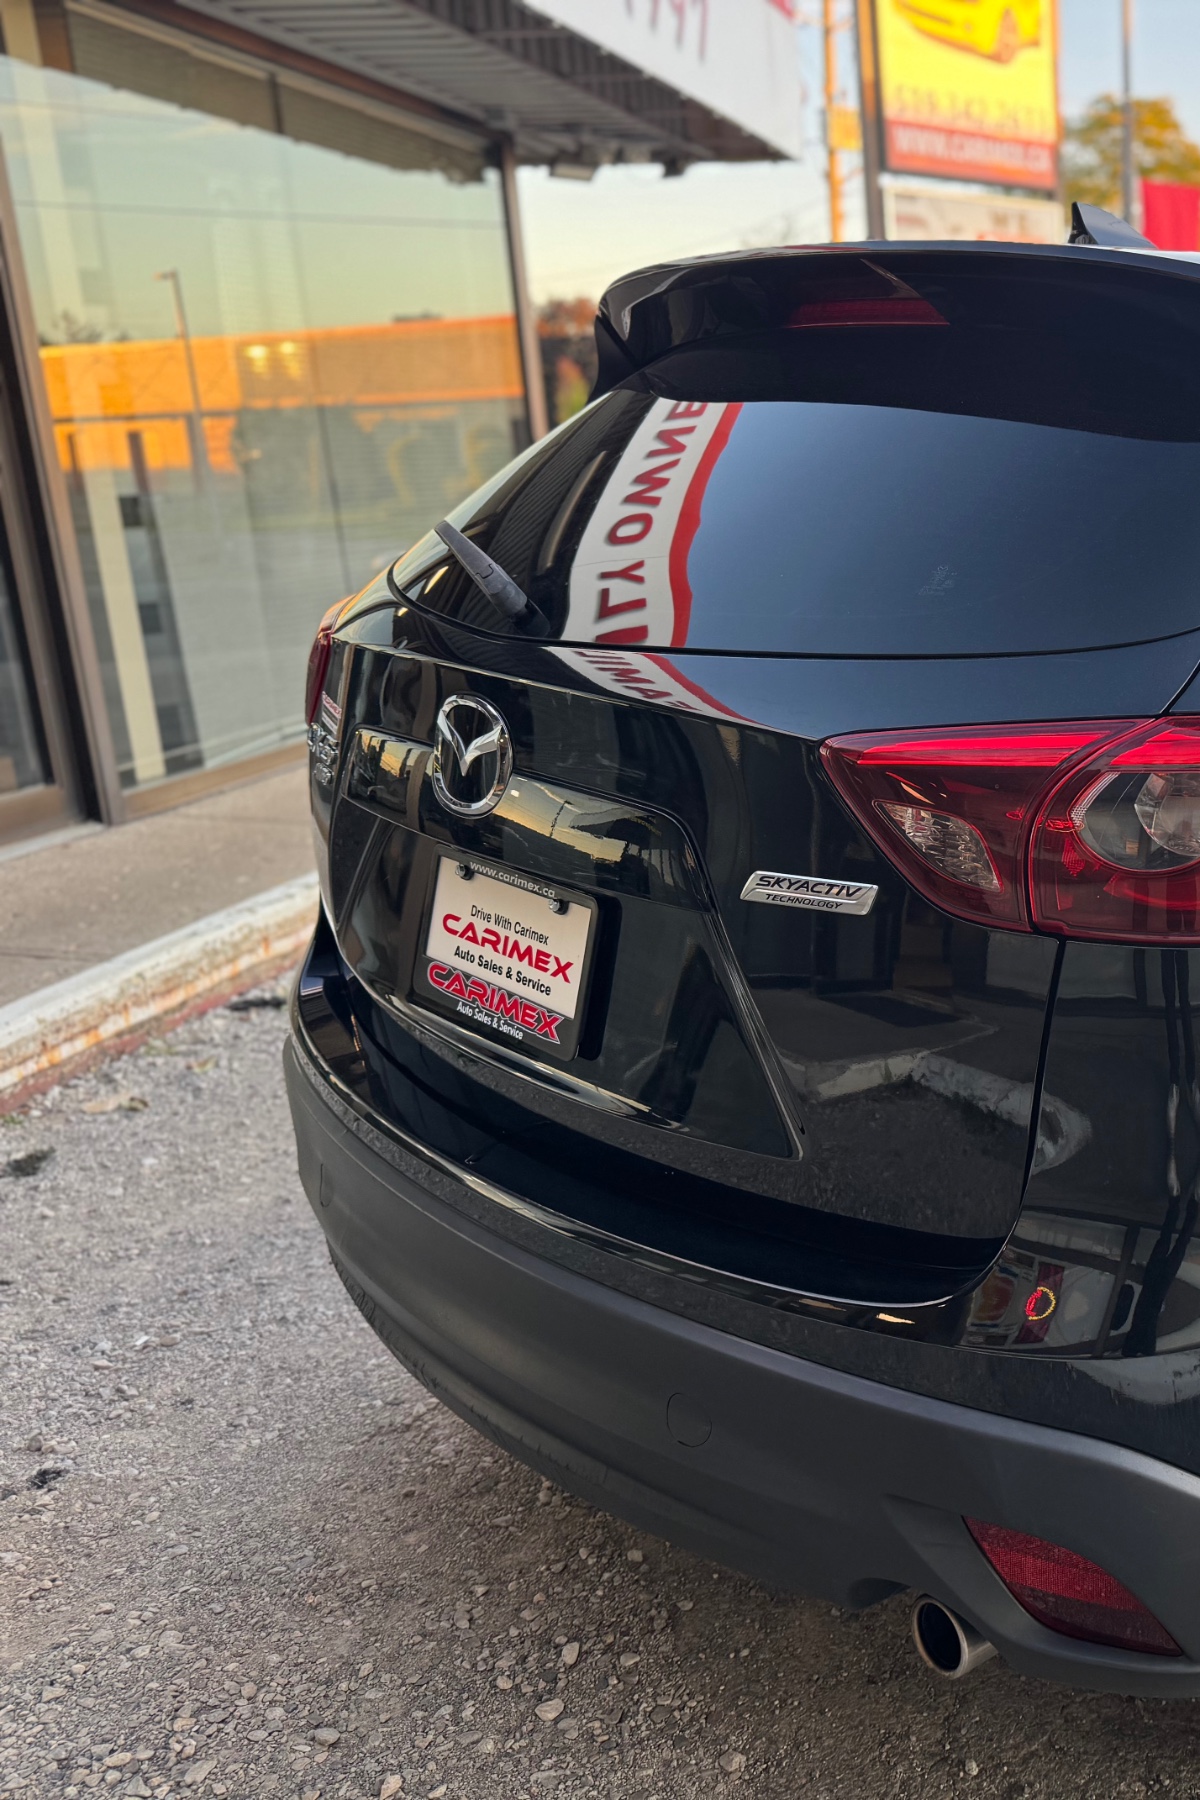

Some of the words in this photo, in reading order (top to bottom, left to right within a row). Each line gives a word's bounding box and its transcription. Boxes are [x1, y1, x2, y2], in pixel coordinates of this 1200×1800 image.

[469, 861, 556, 898] www.carimex.ca
[755, 875, 862, 897] SKYACTIV
[765, 893, 843, 909] TECHNOLOGY
[470, 904, 492, 923] Drive
[494, 912, 512, 931] With
[513, 921, 550, 946] Carimex
[442, 913, 574, 984] CARIMEX
[454, 945, 475, 964] Auto
[477, 954, 503, 976] Sales
[505, 966, 513, 980] &
[515, 970, 551, 996] Service
[428, 962, 562, 1042] CARIMEX
[456, 1001, 473, 1017] Auto
[473, 1009, 492, 1026] Sales
[492, 1018, 499, 1029] &
[499, 1020, 524, 1040] Service
